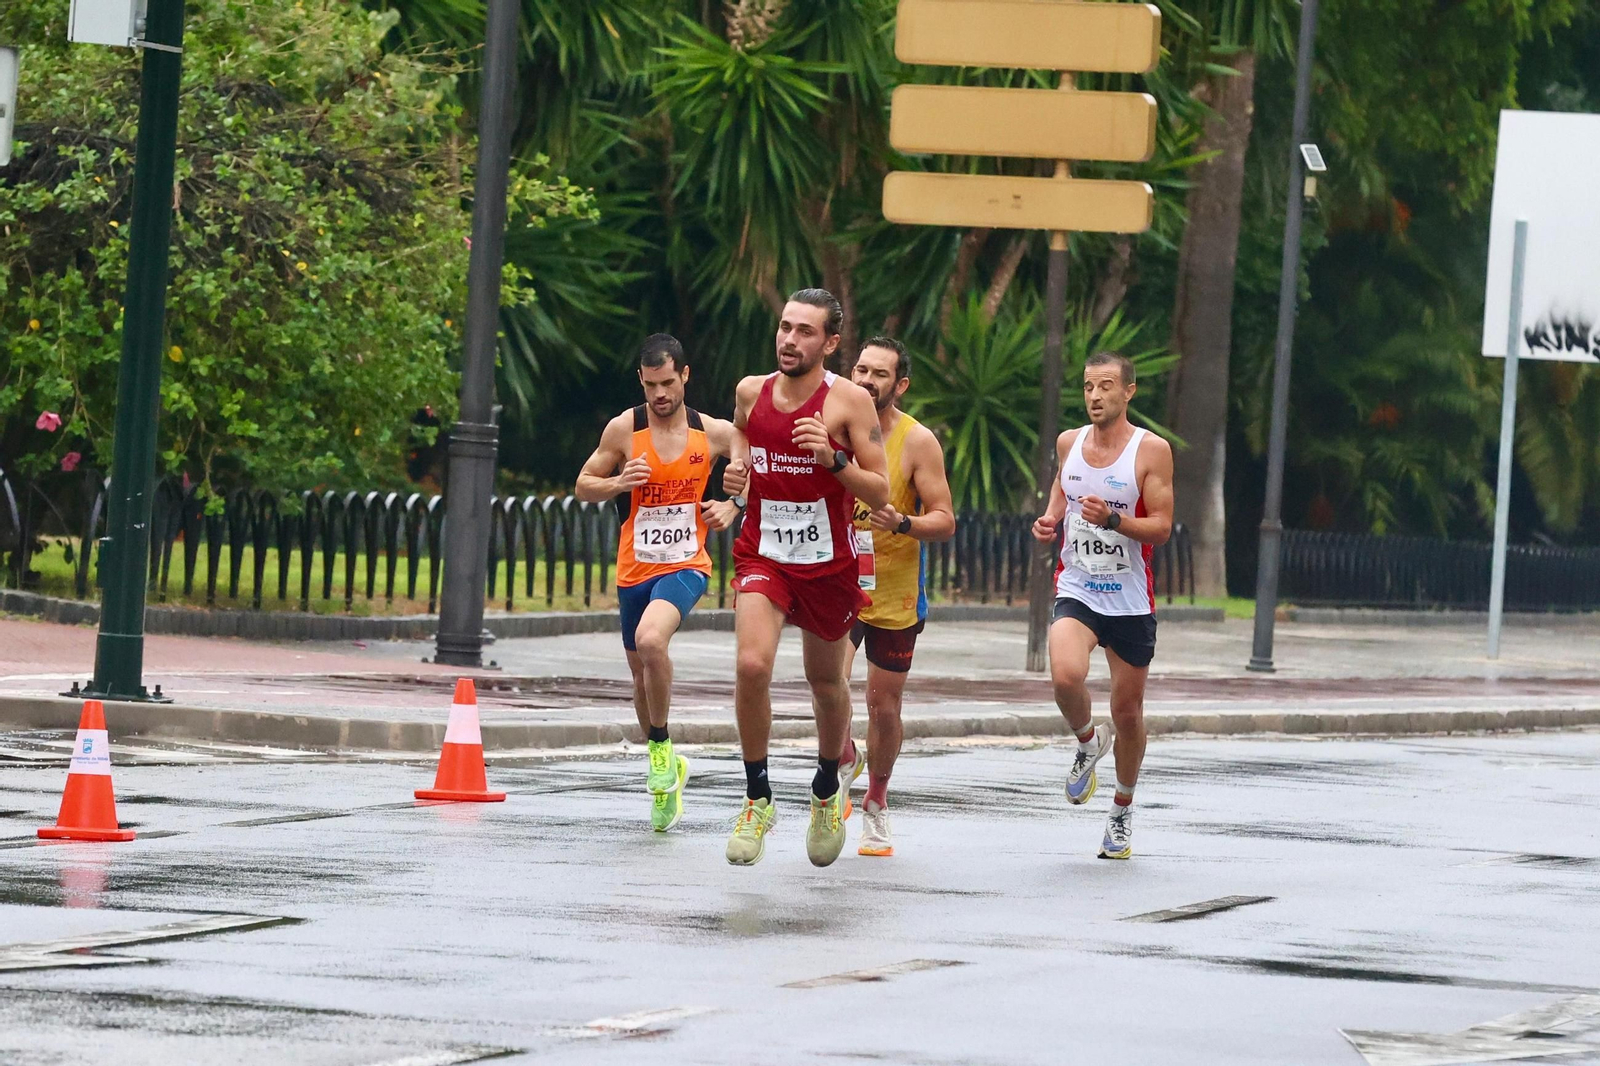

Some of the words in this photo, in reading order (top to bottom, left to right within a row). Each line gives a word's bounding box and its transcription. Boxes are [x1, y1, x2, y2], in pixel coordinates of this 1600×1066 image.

[771, 463, 813, 475] Europea
[665, 478, 693, 488] TEAM
[641, 486, 663, 503] PH
[641, 527, 691, 545] 12601
[773, 525, 820, 545] 1118
